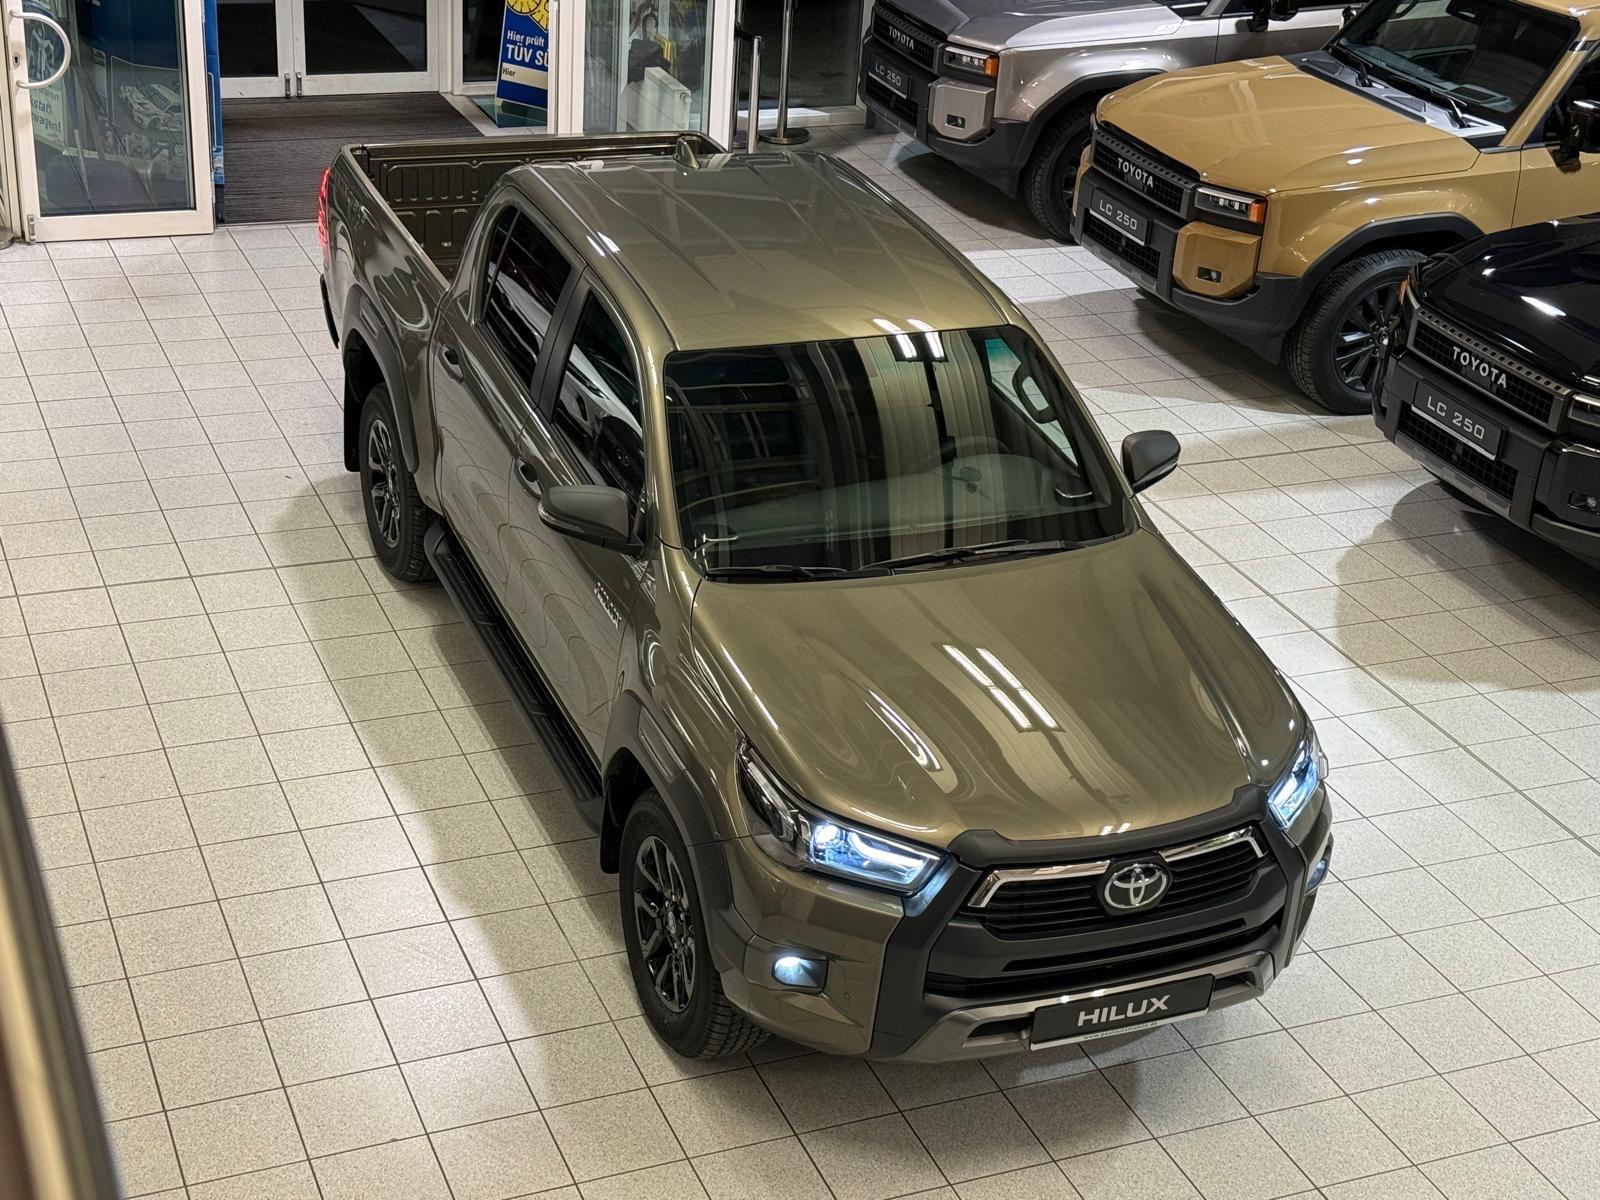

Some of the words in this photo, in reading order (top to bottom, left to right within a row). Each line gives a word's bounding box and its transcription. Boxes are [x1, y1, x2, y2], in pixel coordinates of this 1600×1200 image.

[507, 30, 524, 42] Hier
[525, 35, 545, 47] prüft
[888, 26, 915, 50] TOYOTA
[506, 43, 533, 63] TÜV
[502, 67, 516, 77] Hier
[875, 62, 885, 75] LC
[886, 70, 902, 87] 250
[1117, 157, 1154, 188] TOYOTA
[1099, 199, 1112, 216] LC
[1116, 210, 1138, 231] 250
[1452, 346, 1508, 389] TOYOTA
[1427, 395, 1447, 417] LC
[1451, 412, 1485, 440] 250
[1077, 994, 1171, 1027] HILUX
